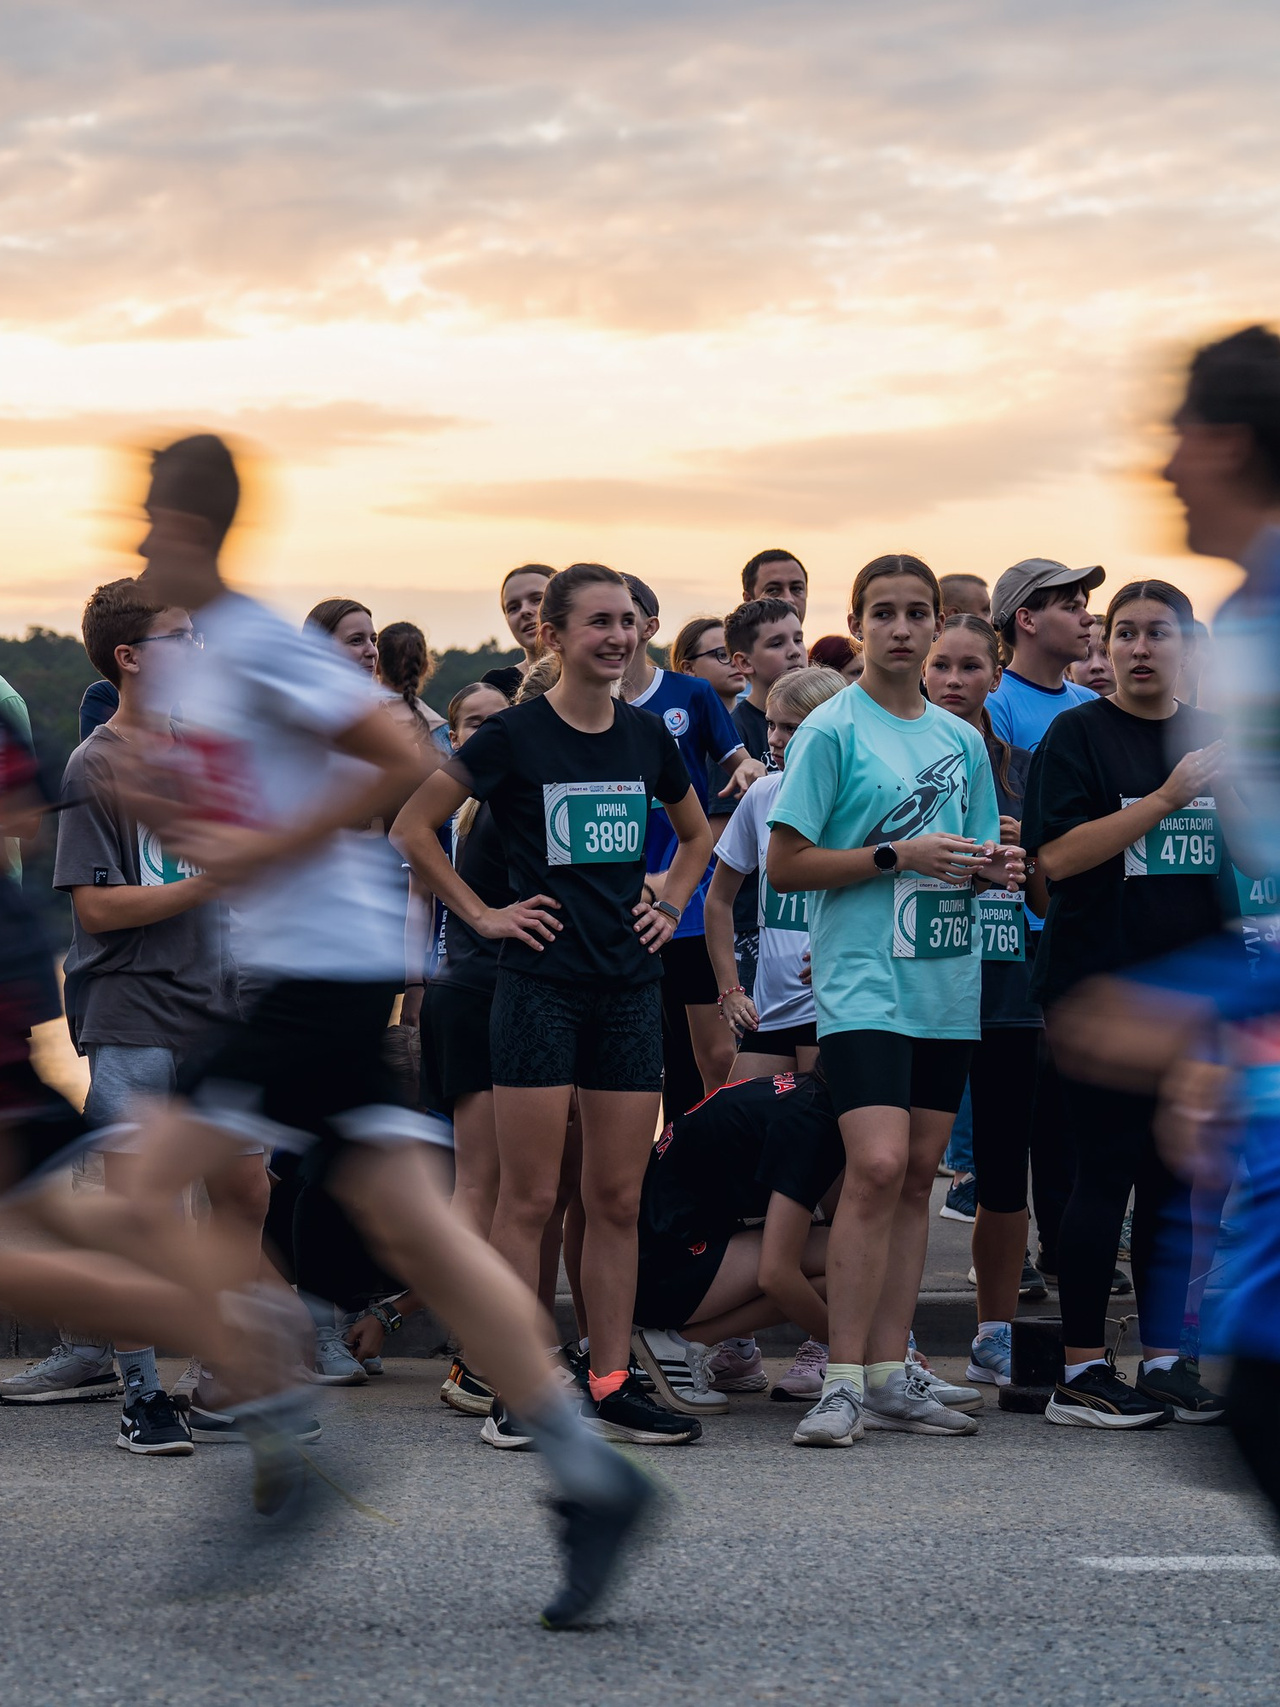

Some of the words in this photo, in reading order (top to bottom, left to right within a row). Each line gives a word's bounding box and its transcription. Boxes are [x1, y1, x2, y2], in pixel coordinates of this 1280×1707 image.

[596, 803, 628, 817] ИРИНА
[1159, 818, 1214, 831] АНАСТАСИЯ
[584, 821, 639, 853] 3890
[1160, 835, 1216, 865] 4795
[938, 899, 966, 913] ПОЛИНА
[929, 915, 969, 948] 3762
